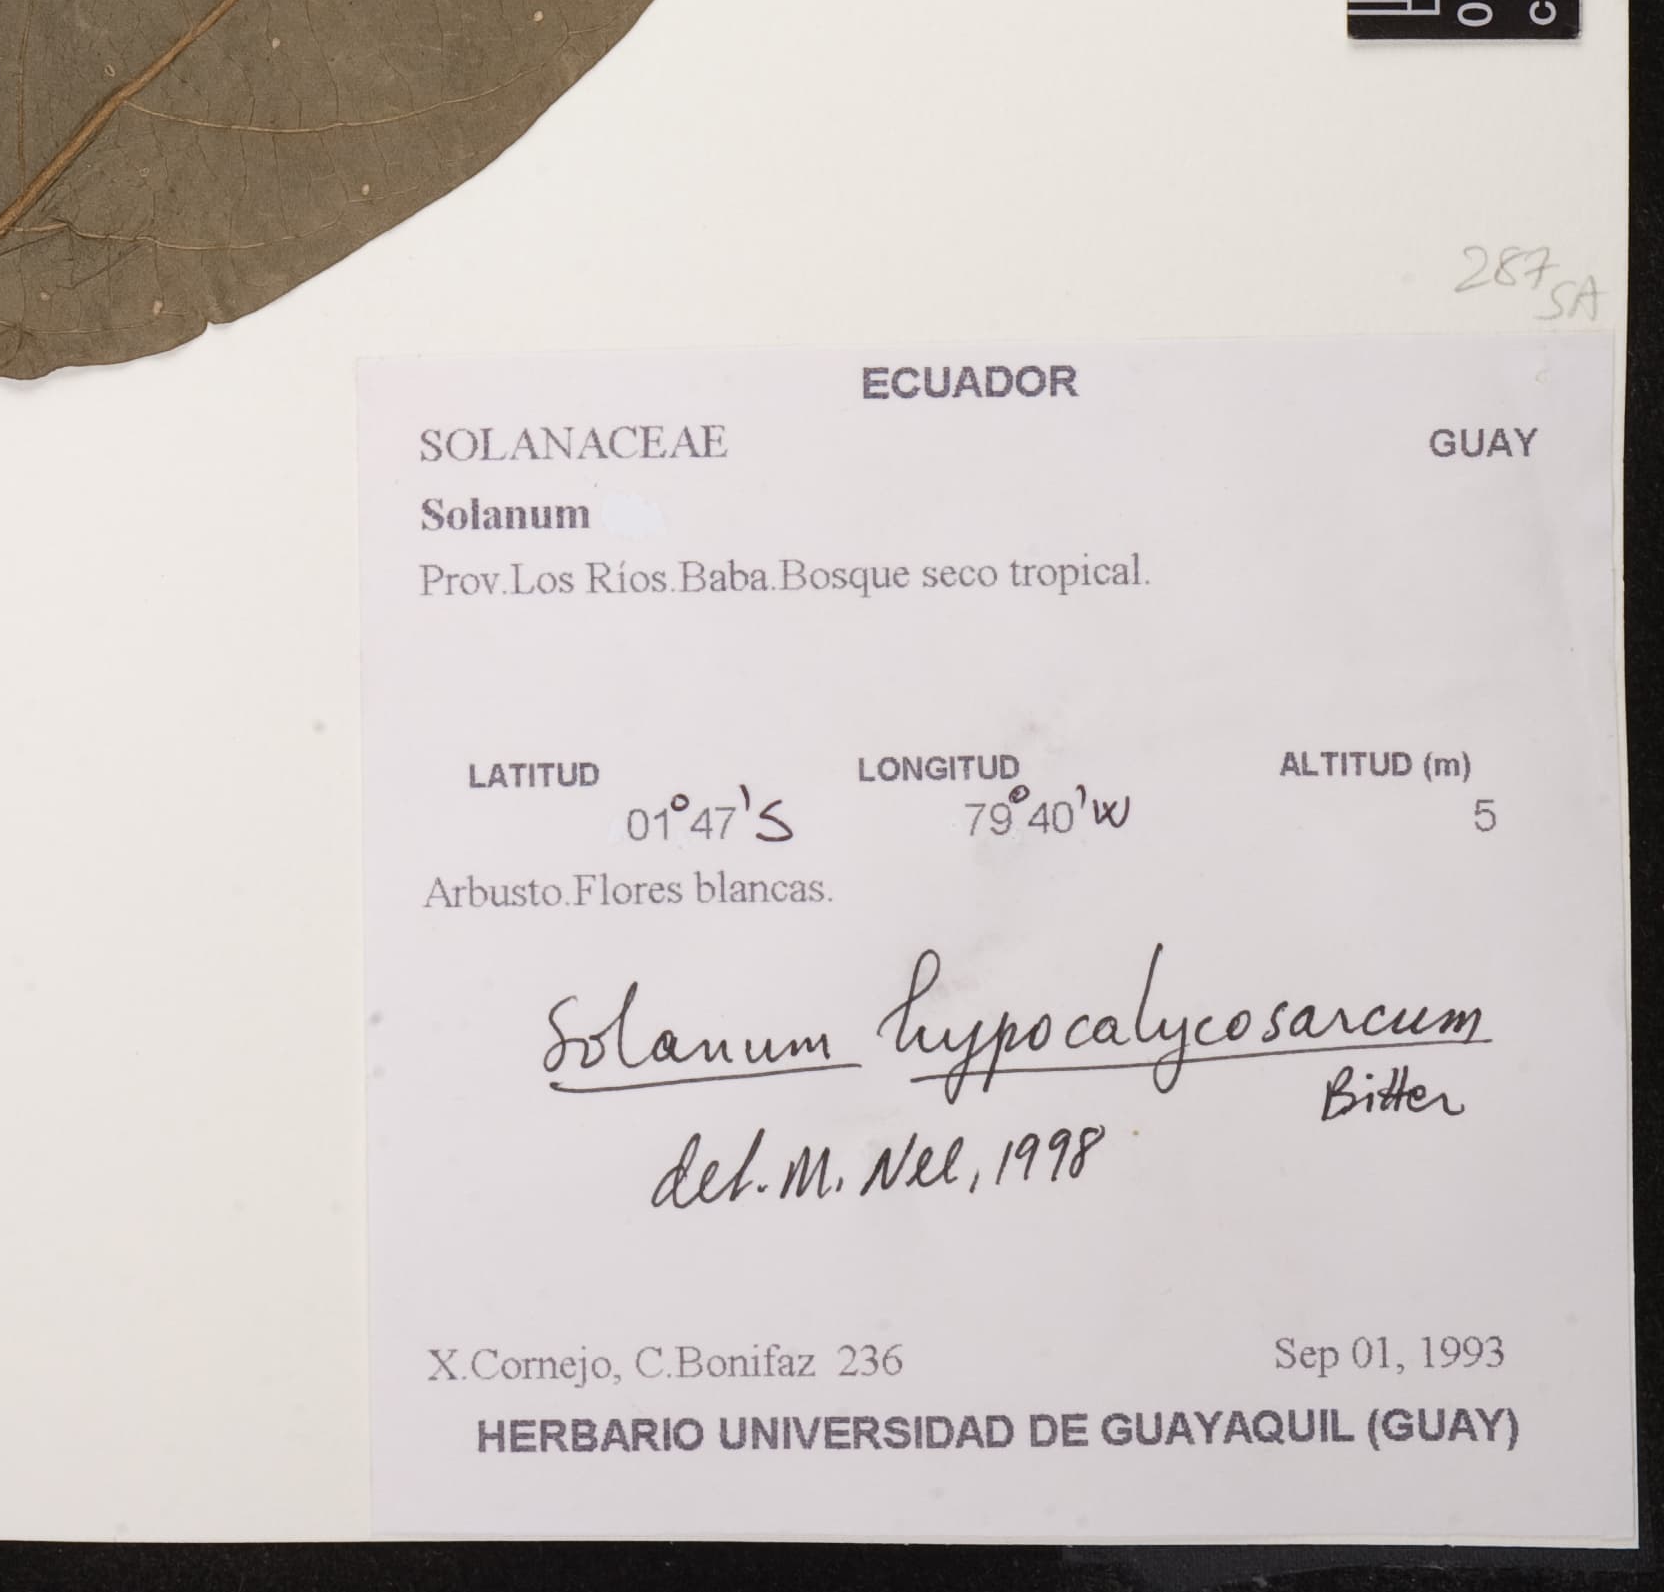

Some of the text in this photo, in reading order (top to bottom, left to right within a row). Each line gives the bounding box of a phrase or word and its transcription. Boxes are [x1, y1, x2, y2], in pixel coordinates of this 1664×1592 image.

[1455, 1, 1494, 28] 0
[1452, 244, 1563, 295] 287
[861, 363, 1080, 401] ECUADOR
[419, 423, 729, 463] SOLANACEAE
[1428, 426, 1540, 459] GUAY
[420, 496, 591, 532] Solanum
[921, 564, 999, 589] seco
[1008, 551, 1151, 597] tropical.
[468, 760, 601, 790] LATITUD
[857, 752, 1021, 784] LONGITUD
[1278, 749, 1472, 785] ALTITUD (m)
[1473, 797, 1498, 834] 5
[422, 869, 834, 909] Arbusto.Flores blancas.
[541, 941, 1490, 1097] Solanum hypocalycosarcum
[1319, 1068, 1466, 1123] Bitter
[994, 1123, 1107, 1187] 1998
[427, 1342, 904, 1390] X.Cornejo, C.Bonifaz 236
[1274, 1334, 1506, 1380] Sep 01, 1993
[476, 1406, 1520, 1454] HERBARIO UNIVERSIDAD DE GUAYAQUIL (GUAY)
